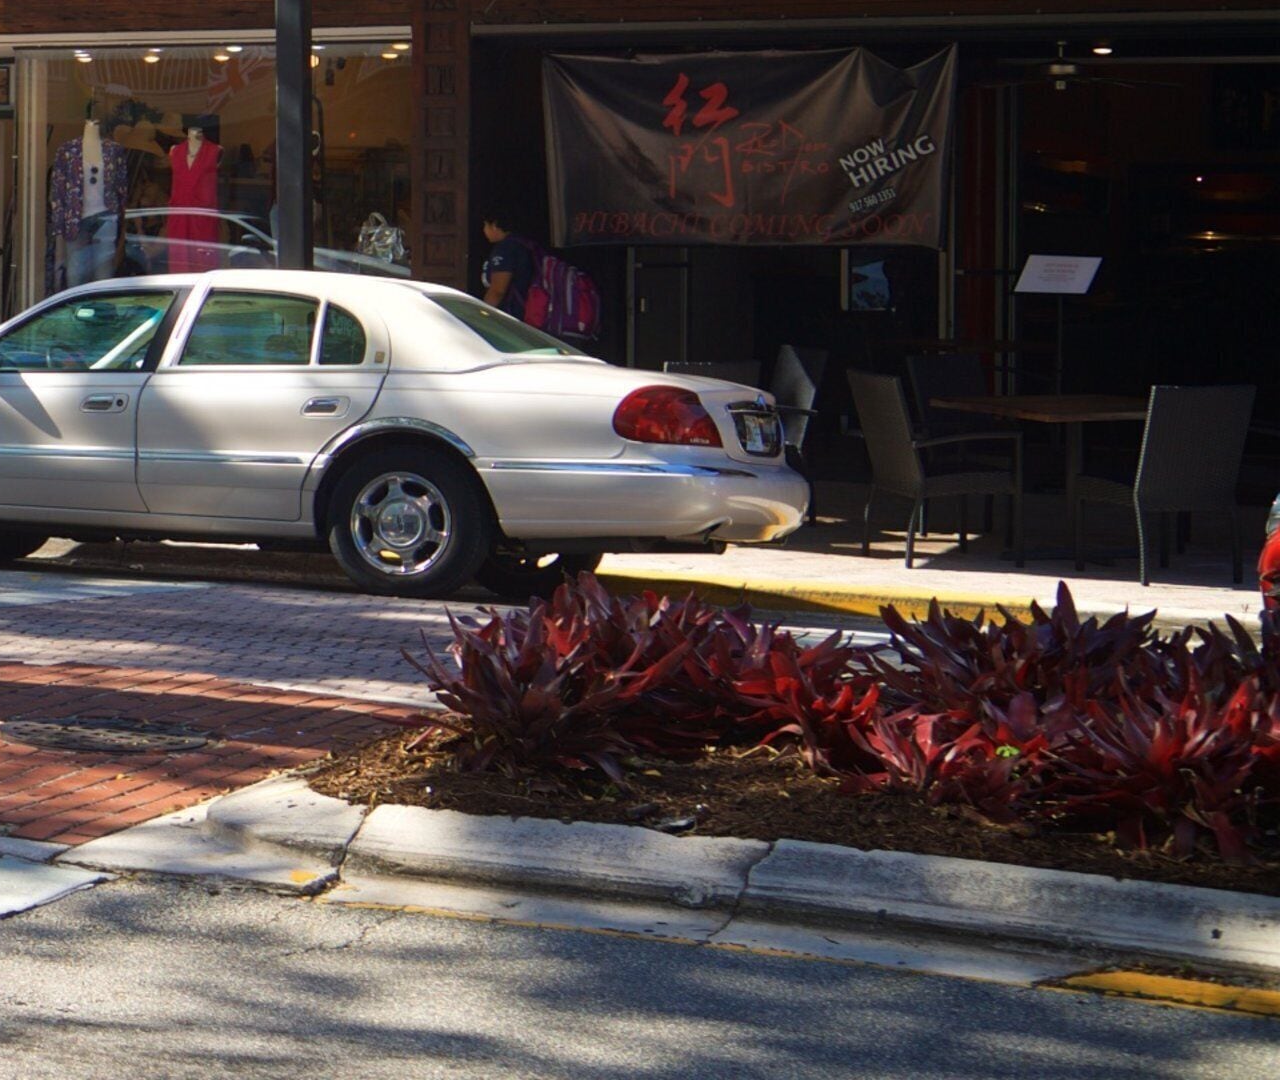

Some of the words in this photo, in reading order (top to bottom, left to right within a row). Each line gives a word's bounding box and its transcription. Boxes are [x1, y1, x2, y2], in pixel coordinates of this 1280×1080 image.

[740, 159, 832, 176] BISTRO
[839, 138, 886, 172] NOW
[848, 135, 936, 188] HIRING
[574, 209, 700, 238] HIBACHI
[710, 212, 834, 243] COMING
[840, 211, 932, 240] SOON
